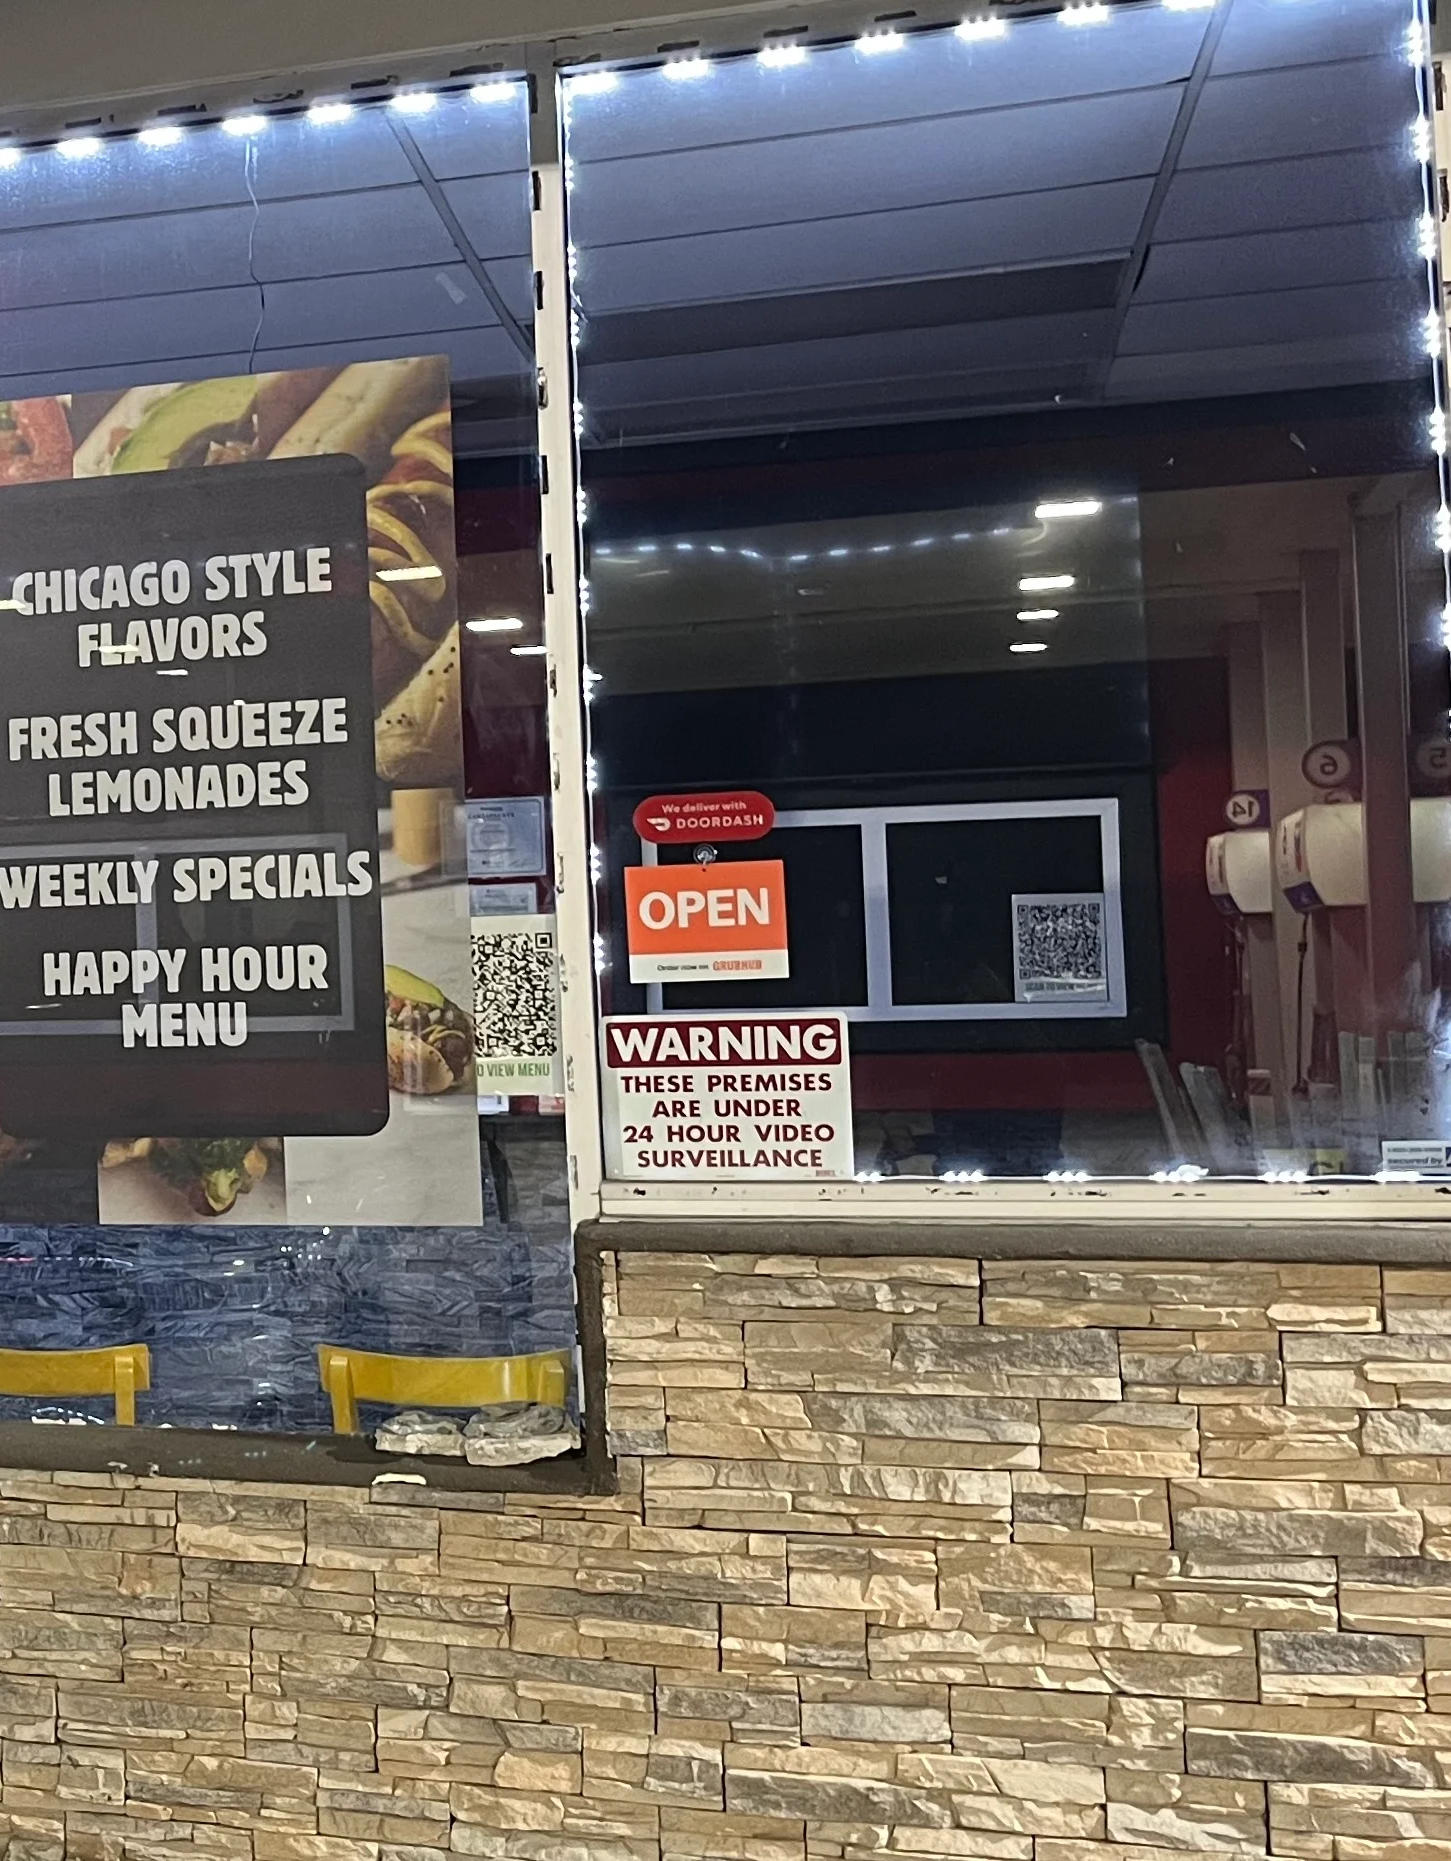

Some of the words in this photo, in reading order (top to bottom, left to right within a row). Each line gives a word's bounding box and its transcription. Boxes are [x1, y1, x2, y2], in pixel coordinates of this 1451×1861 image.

[11, 558, 190, 616] CHICAGO
[205, 547, 332, 601] STYLE
[78, 611, 268, 668] FLAVORS
[8, 710, 138, 761] FRESH
[152, 697, 348, 754] SQUEEZE
[48, 759, 310, 817] LEMONADES
[661, 804, 680, 814] We
[682, 802, 720, 813] deliver
[722, 800, 747, 811] with
[676, 814, 764, 829] DOORDASH
[172, 850, 373, 903] SPECIALS
[639, 887, 770, 930] OPEN
[42, 948, 187, 997] HAPPY
[201, 944, 329, 992] HOUR
[712, 960, 762, 971] GRUBHUB
[121, 1001, 249, 1048] MENU
[610, 1023, 837, 1063] WARNING
[486, 1064, 515, 1077] VIEW
[518, 1063, 550, 1077] MENU
[621, 1075, 694, 1093] THESE
[707, 1072, 832, 1092] PREMISES
[652, 1100, 700, 1118] ARE
[714, 1098, 802, 1117] UNDER
[623, 1125, 653, 1143] 24
[667, 1124, 741, 1143] HOUR
[754, 1123, 835, 1142] VIDEO
[637, 1149, 823, 1168] SURVEILLANCE
